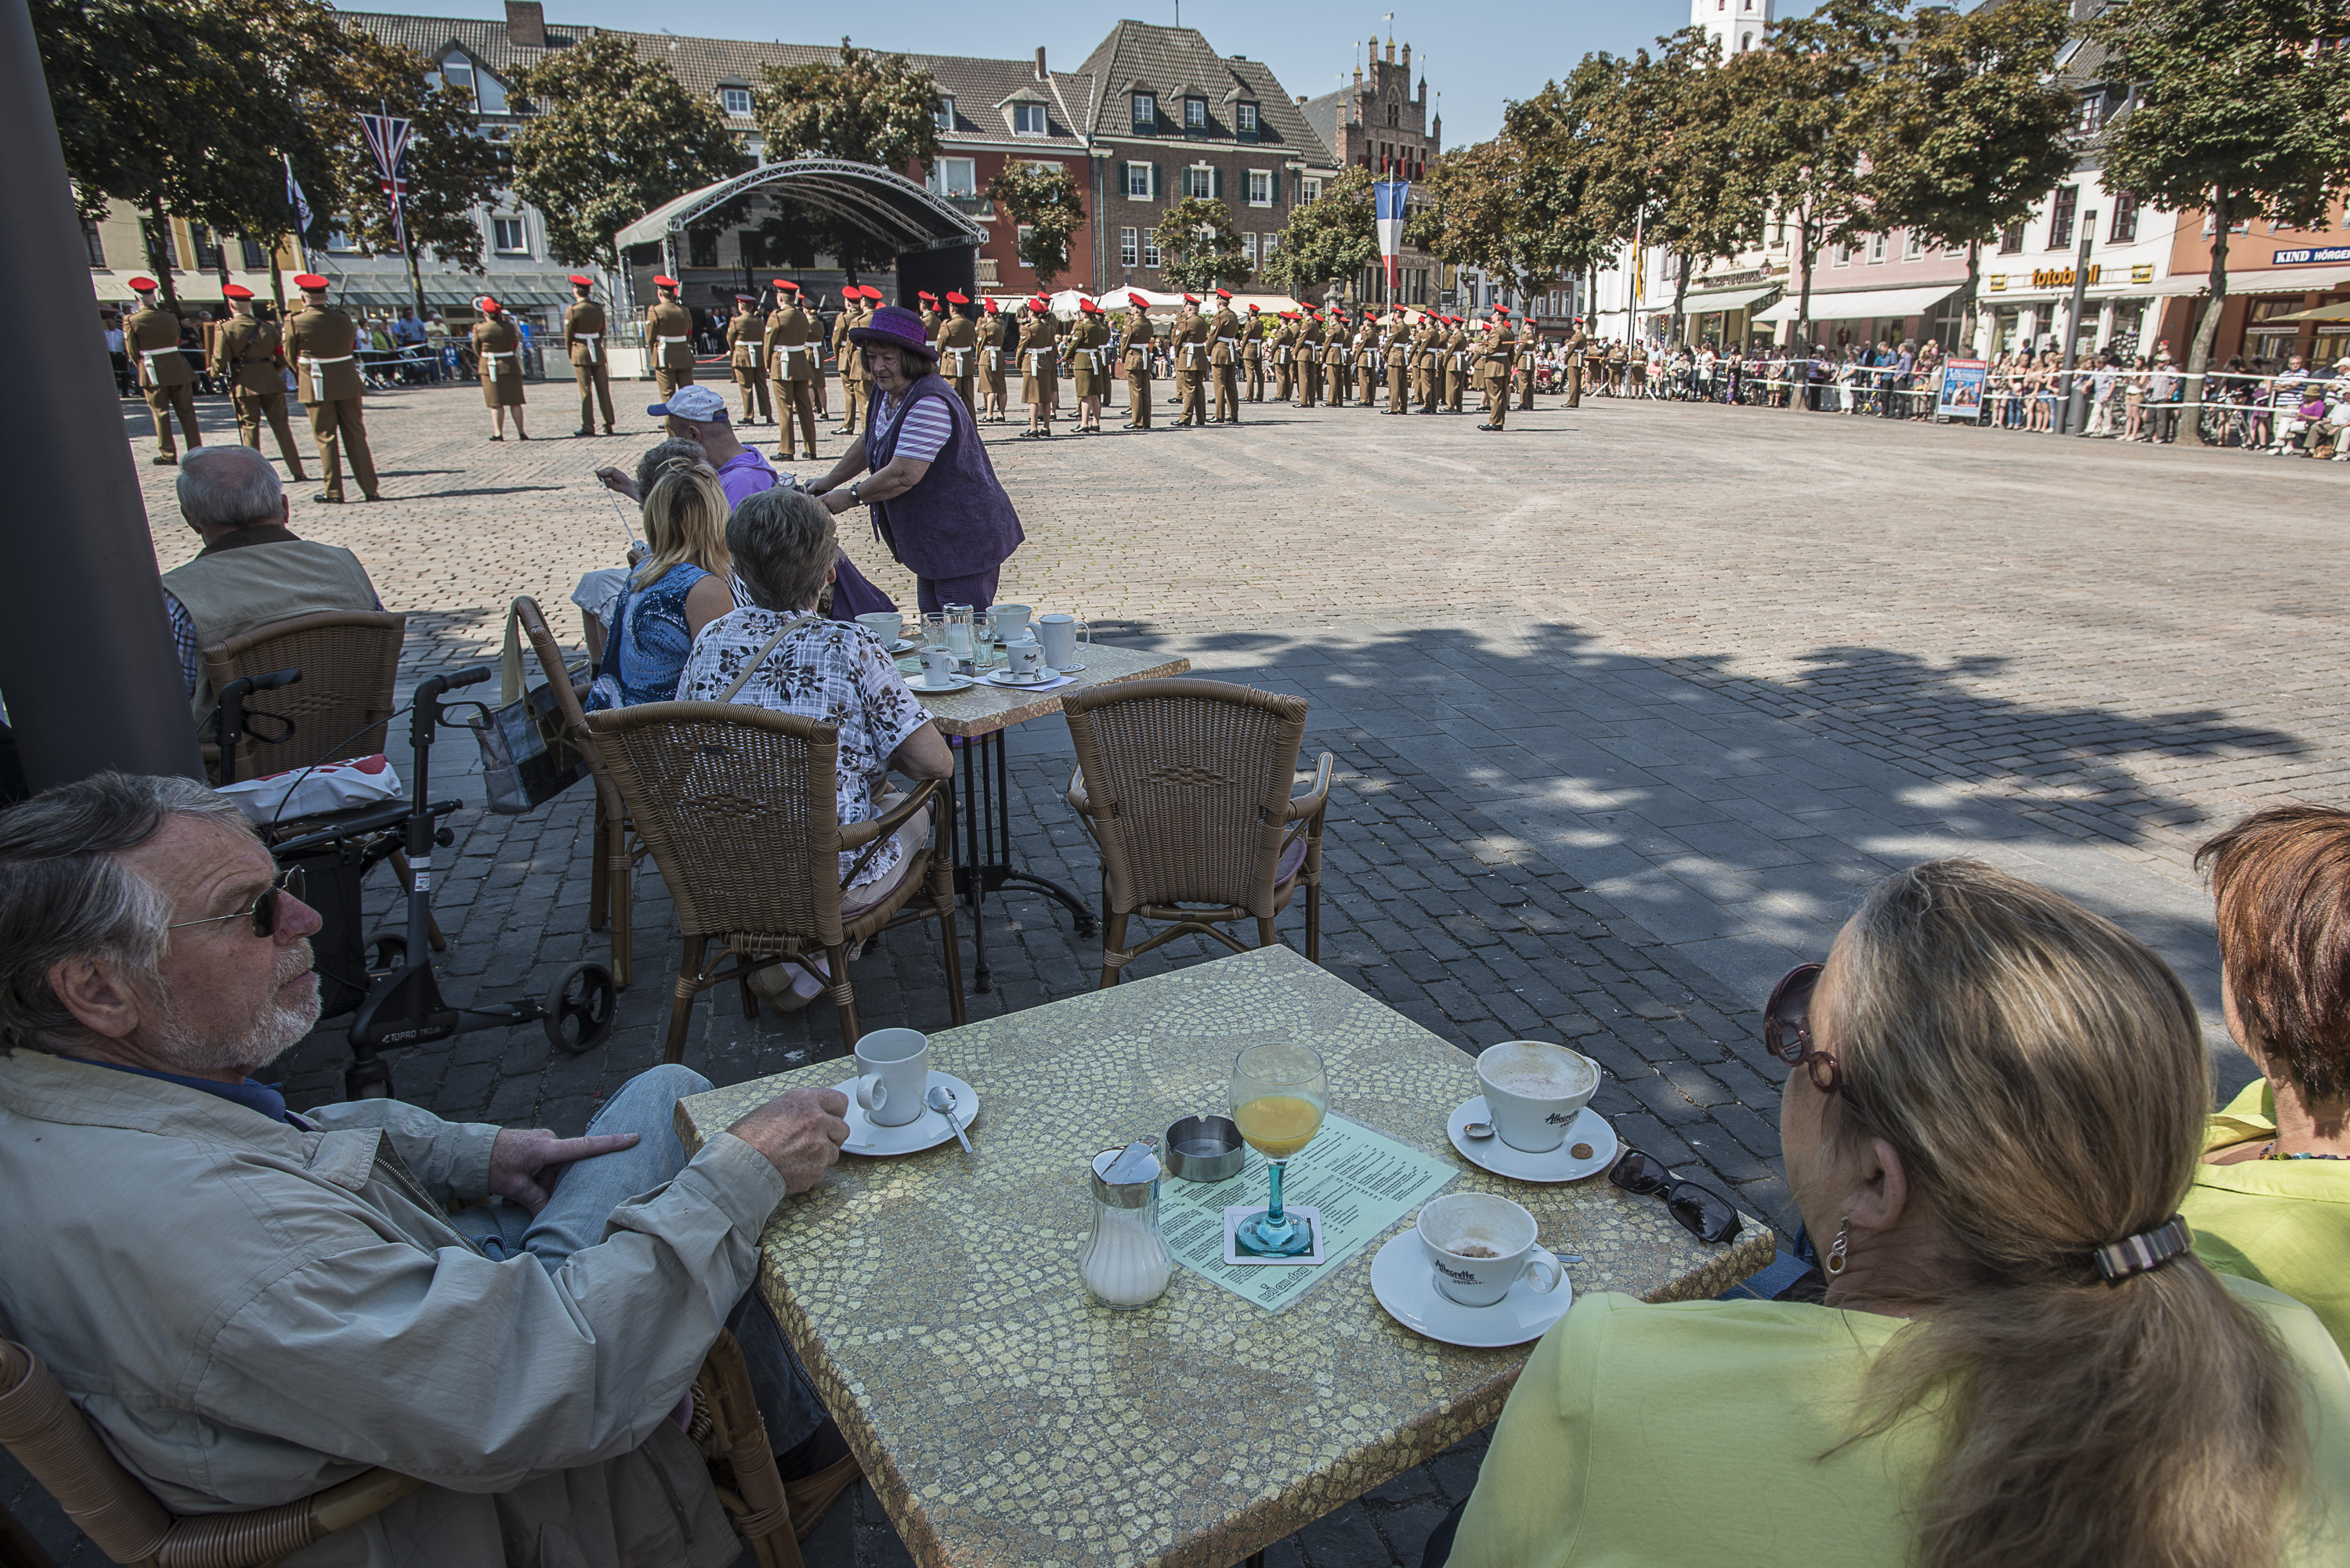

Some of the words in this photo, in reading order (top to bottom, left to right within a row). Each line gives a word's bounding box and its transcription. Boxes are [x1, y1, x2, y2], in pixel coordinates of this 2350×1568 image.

[2275, 250, 2310, 263] KIND
[391, 1030, 417, 1042] TOPRO
[420, 1026, 441, 1035] TROJA
[1275, 1278, 1292, 1290] am
[1288, 1266, 1309, 1281] dom
[1434, 1259, 1475, 1280] Allegretto
